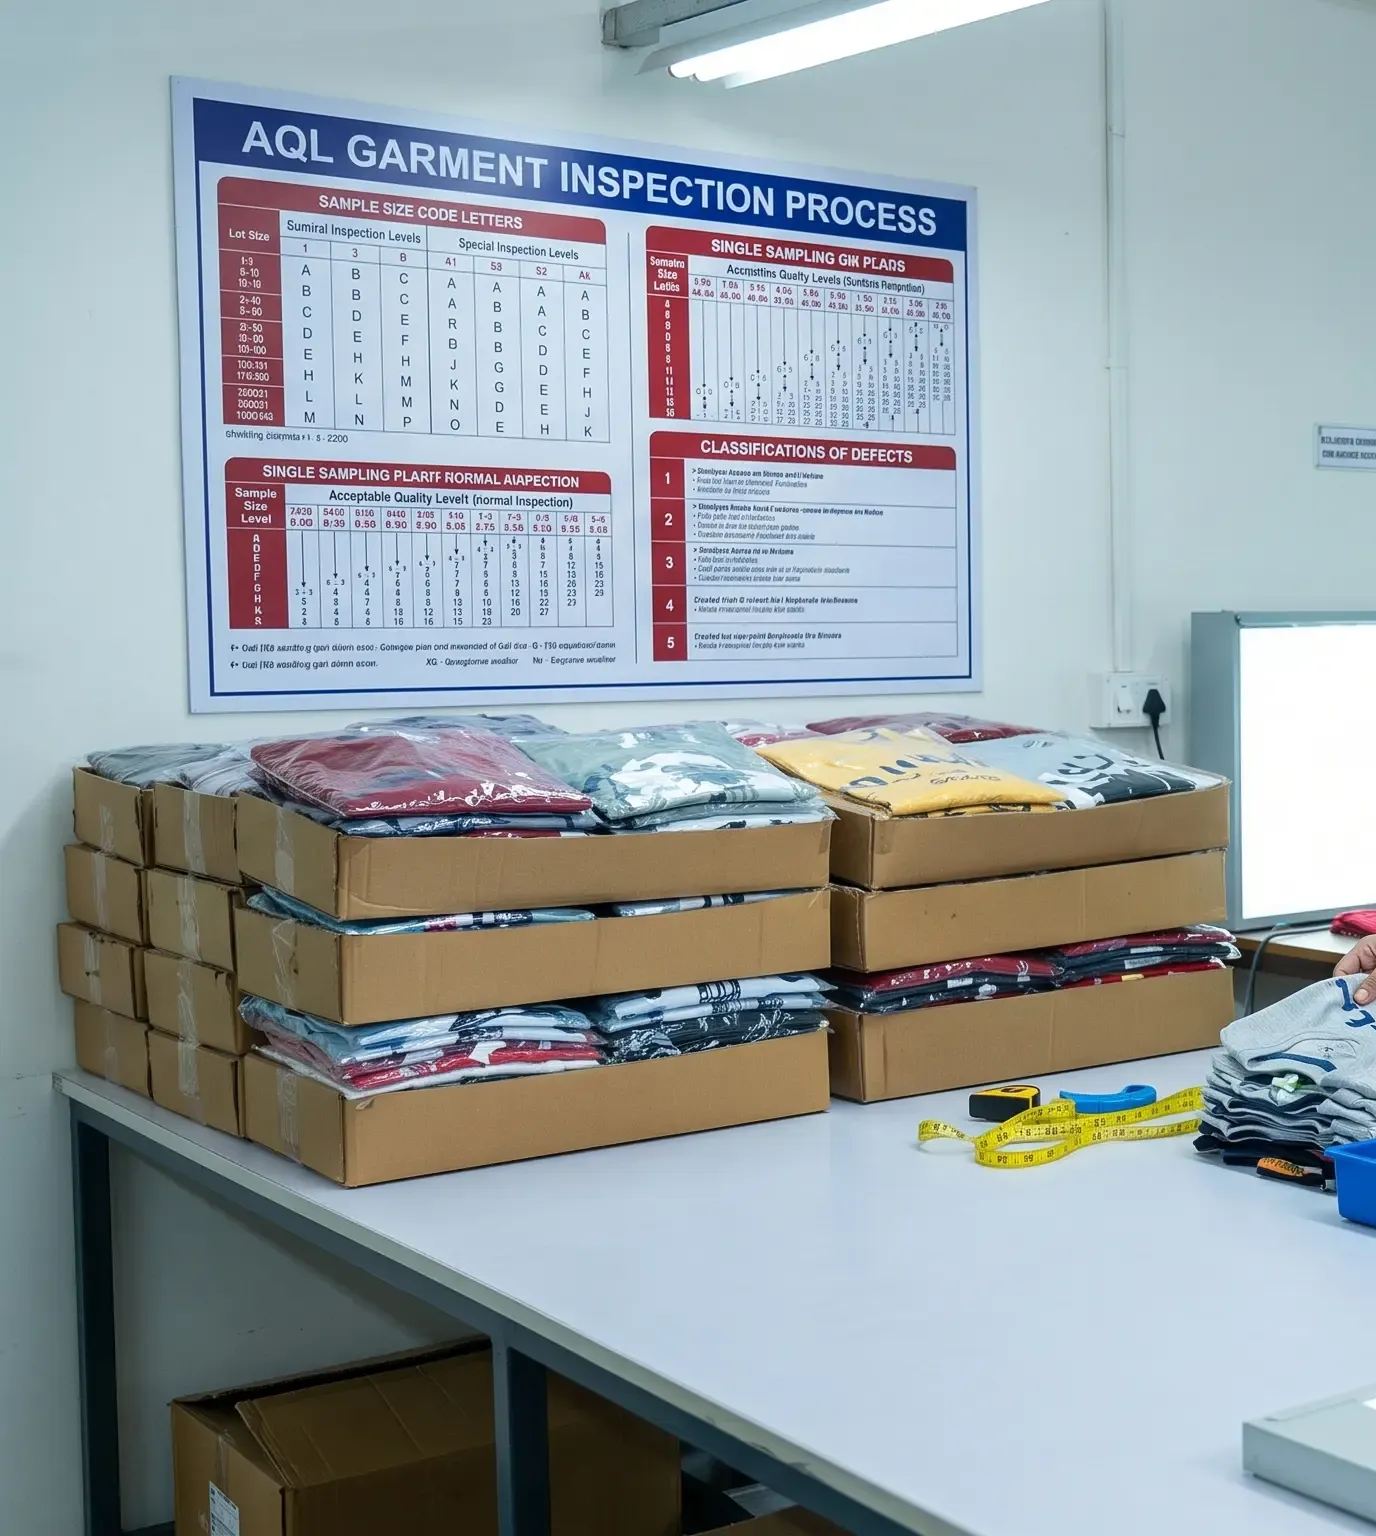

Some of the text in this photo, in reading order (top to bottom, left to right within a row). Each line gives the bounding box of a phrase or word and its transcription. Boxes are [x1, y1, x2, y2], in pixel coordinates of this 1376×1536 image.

[242, 121, 937, 236] AQL GARMENT INSPECTION PROCESS
[383, 202, 414, 217] SIZE
[418, 206, 458, 222] CODE
[462, 211, 523, 229] LETTERS
[229, 228, 246, 239] Lot
[287, 220, 421, 244] Sumiral Inspection Levels
[303, 244, 307, 252] 1
[352, 248, 358, 258] 3
[459, 237, 579, 260] Special Inspection Levels
[711, 239, 762, 256] SINGLE
[766, 245, 835, 265] SAMPLING
[301, 264, 589, 301] A B C A A A A
[812, 273, 841, 285] Levels
[302, 285, 589, 320] B B C A B A B
[302, 306, 312, 318] C
[352, 310, 361, 321] D
[401, 314, 409, 326] E
[494, 321, 502, 333] B
[538, 325, 547, 336] C
[582, 329, 590, 340] C
[303, 327, 312, 339] D
[353, 331, 362, 343] E
[402, 335, 409, 346] F
[494, 342, 502, 353] B
[539, 345, 547, 356] D
[583, 348, 590, 359] E
[304, 348, 590, 378] E H H J G D F
[304, 370, 591, 398] H K M K G E H
[306, 391, 590, 418] L L M N D E J
[304, 411, 592, 437] M N P O E H K
[701, 440, 912, 463] CLASSIFICATIONS OF DEFECTS
[263, 465, 315, 478] SINGLE
[319, 467, 390, 481] SAMPLING
[665, 472, 670, 484] 1
[235, 487, 277, 500] Sample
[329, 490, 391, 504] Acceptable
[394, 492, 432, 506] Quality
[516, 496, 573, 510] Inspection)
[244, 501, 268, 511] Size
[241, 514, 271, 523] Level
[665, 513, 672, 526] 2
[253, 534, 260, 542] A
[254, 554, 260, 562] E
[666, 556, 673, 568] 3
[254, 572, 260, 581] F
[254, 584, 261, 592] G
[511, 589, 520, 597] 12
[254, 594, 261, 603] H
[301, 597, 306, 605] 5
[482, 598, 492, 606] 10
[539, 598, 549, 606] 22
[666, 599, 674, 611] 4
[255, 606, 262, 614] K
[302, 608, 307, 616] 2
[424, 608, 433, 616] 12
[511, 608, 521, 616] 20
[540, 608, 549, 616] 27
[667, 637, 674, 648] 5
